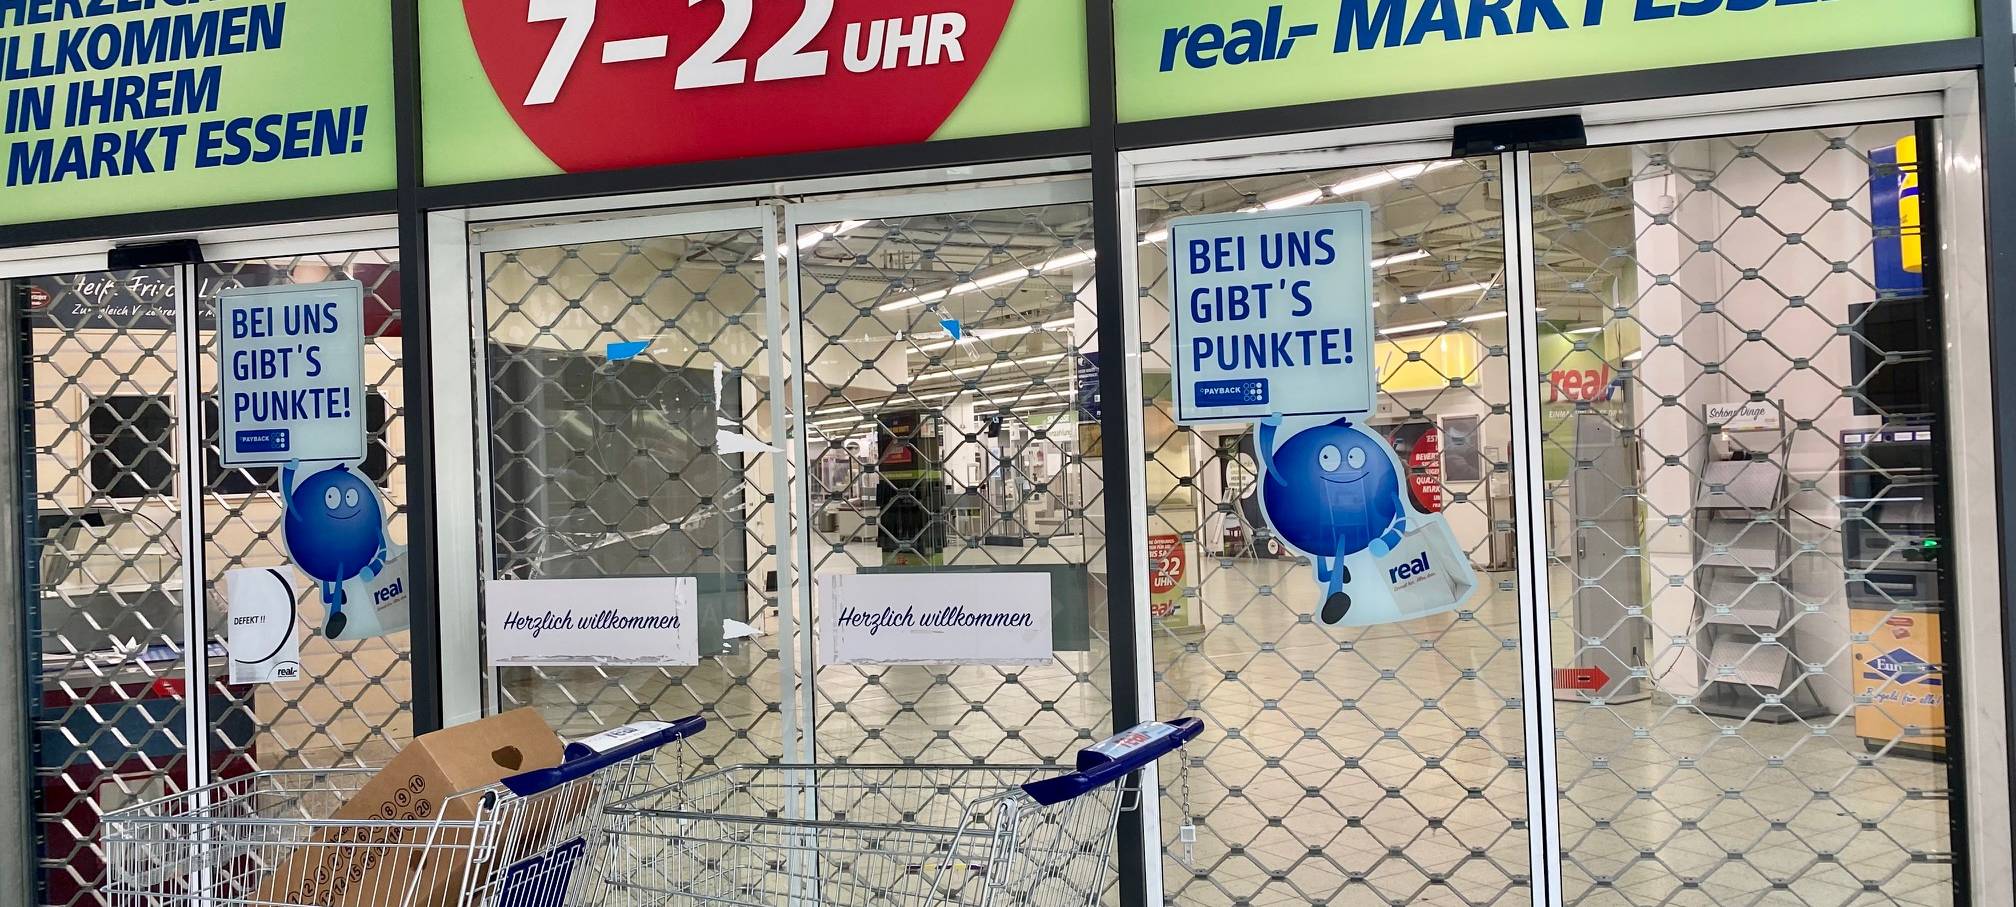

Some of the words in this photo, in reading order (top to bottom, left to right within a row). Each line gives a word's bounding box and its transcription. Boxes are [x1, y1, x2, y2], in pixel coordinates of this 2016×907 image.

[842, 12, 967, 73] UHR
[5, 84, 56, 134] IN
[64, 65, 222, 128] IHREM
[6, 123, 187, 187] MARKT
[195, 104, 368, 169] ESSEN!
[1189, 236, 1246, 275] BEI
[1260, 228, 1336, 269] UNS
[1190, 278, 1313, 324] GIBT'S
[232, 306, 273, 339] BEI
[284, 302, 339, 335] UNS
[232, 343, 322, 381] GIBT'S
[1192, 328, 1354, 372] PUNKTE!
[234, 387, 352, 423] PUNKTE!
[1204, 386, 1241, 395] PAYBACK
[242, 435, 270, 443] PAYBACK
[1389, 551, 1430, 584] real
[373, 577, 403, 605] real
[233, 616, 259, 625] DEFEKT
[503, 609, 574, 638] Herzlich
[578, 609, 680, 630] willkommen
[838, 605, 915, 636] Herzlich
[919, 605, 1033, 627] willkommen
[411, 777, 424, 791] 10
[350, 866, 361, 881] 15
[416, 800, 430, 816] 20
